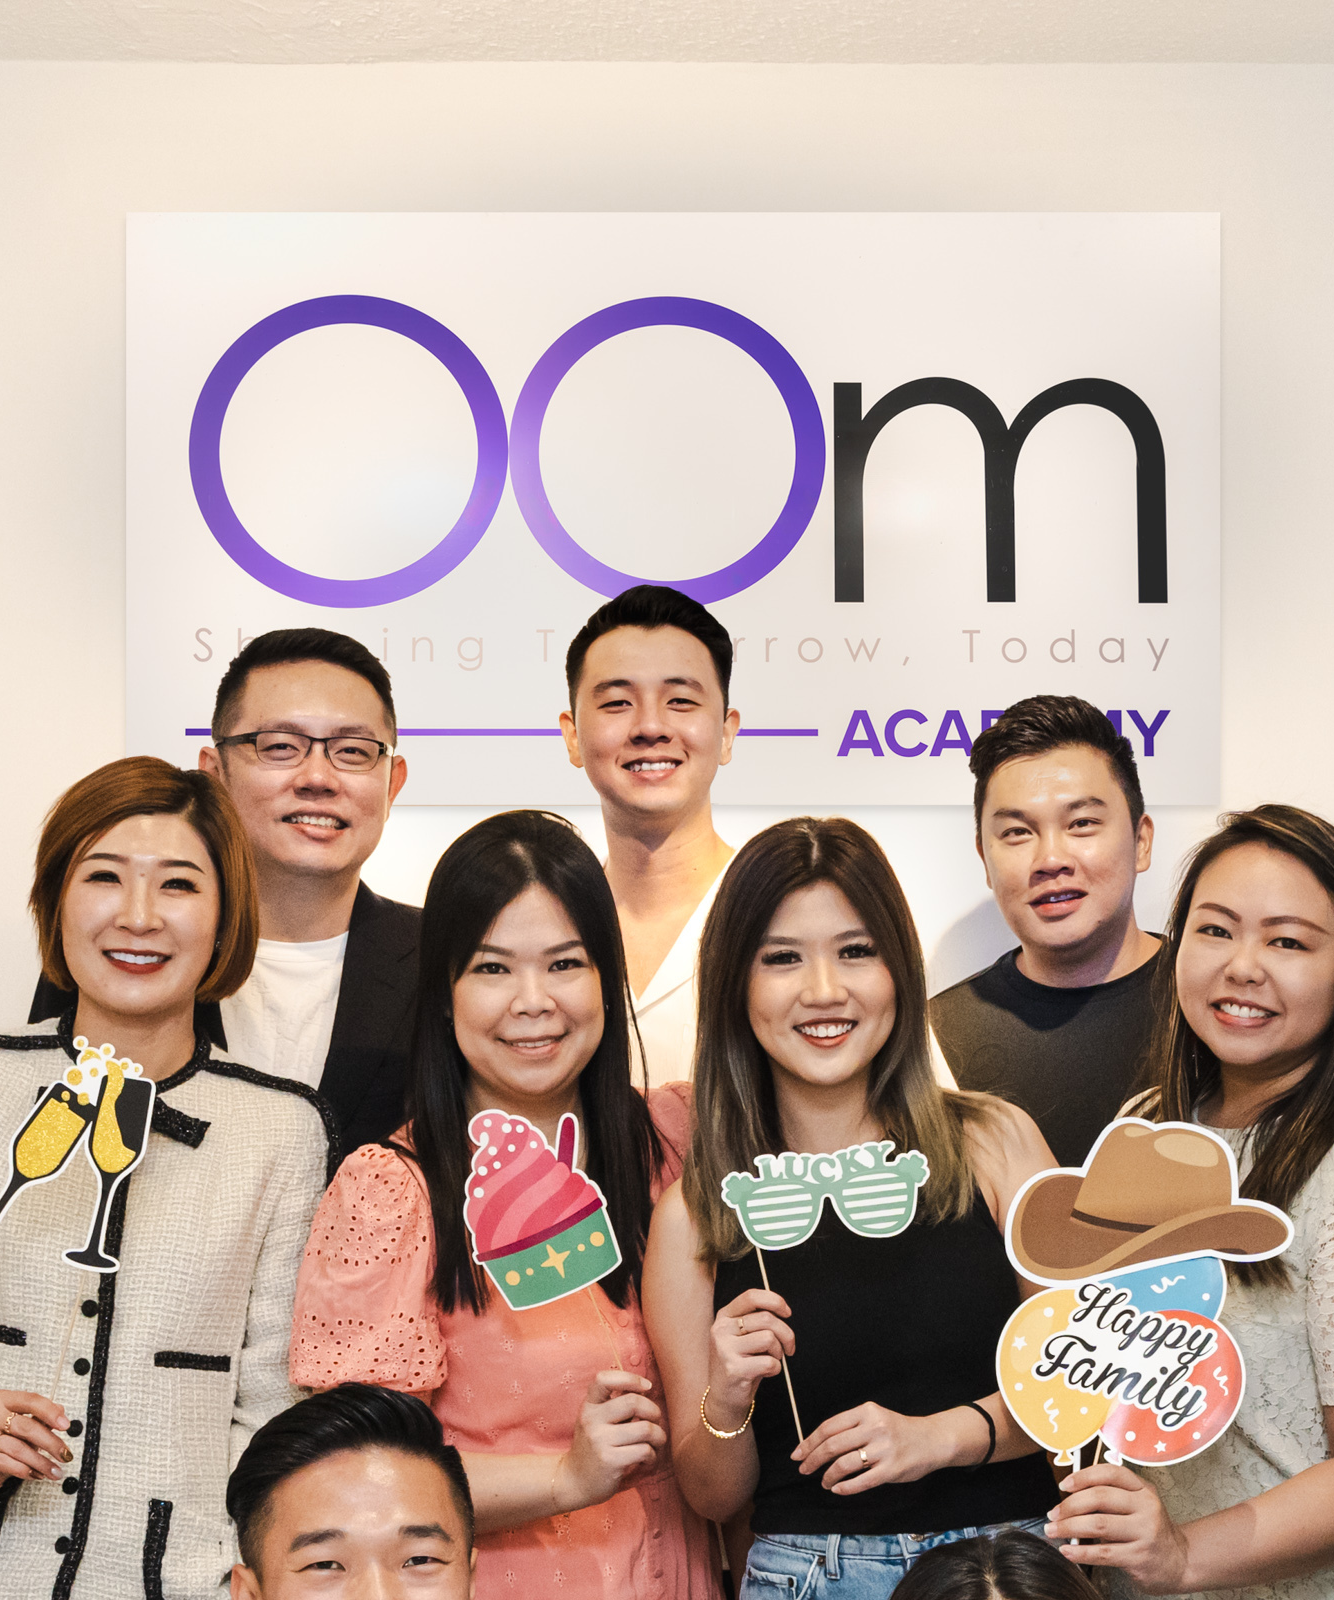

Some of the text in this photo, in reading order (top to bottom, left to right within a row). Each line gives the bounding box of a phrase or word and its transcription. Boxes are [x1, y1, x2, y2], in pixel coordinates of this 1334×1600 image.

[193, 626, 1171, 672] Shing Trrow, Today
[836, 708, 1172, 758] ACAY
[756, 1143, 893, 1184] LUCKY
[1072, 1283, 1214, 1366] Happy
[1035, 1334, 1203, 1427] Family
